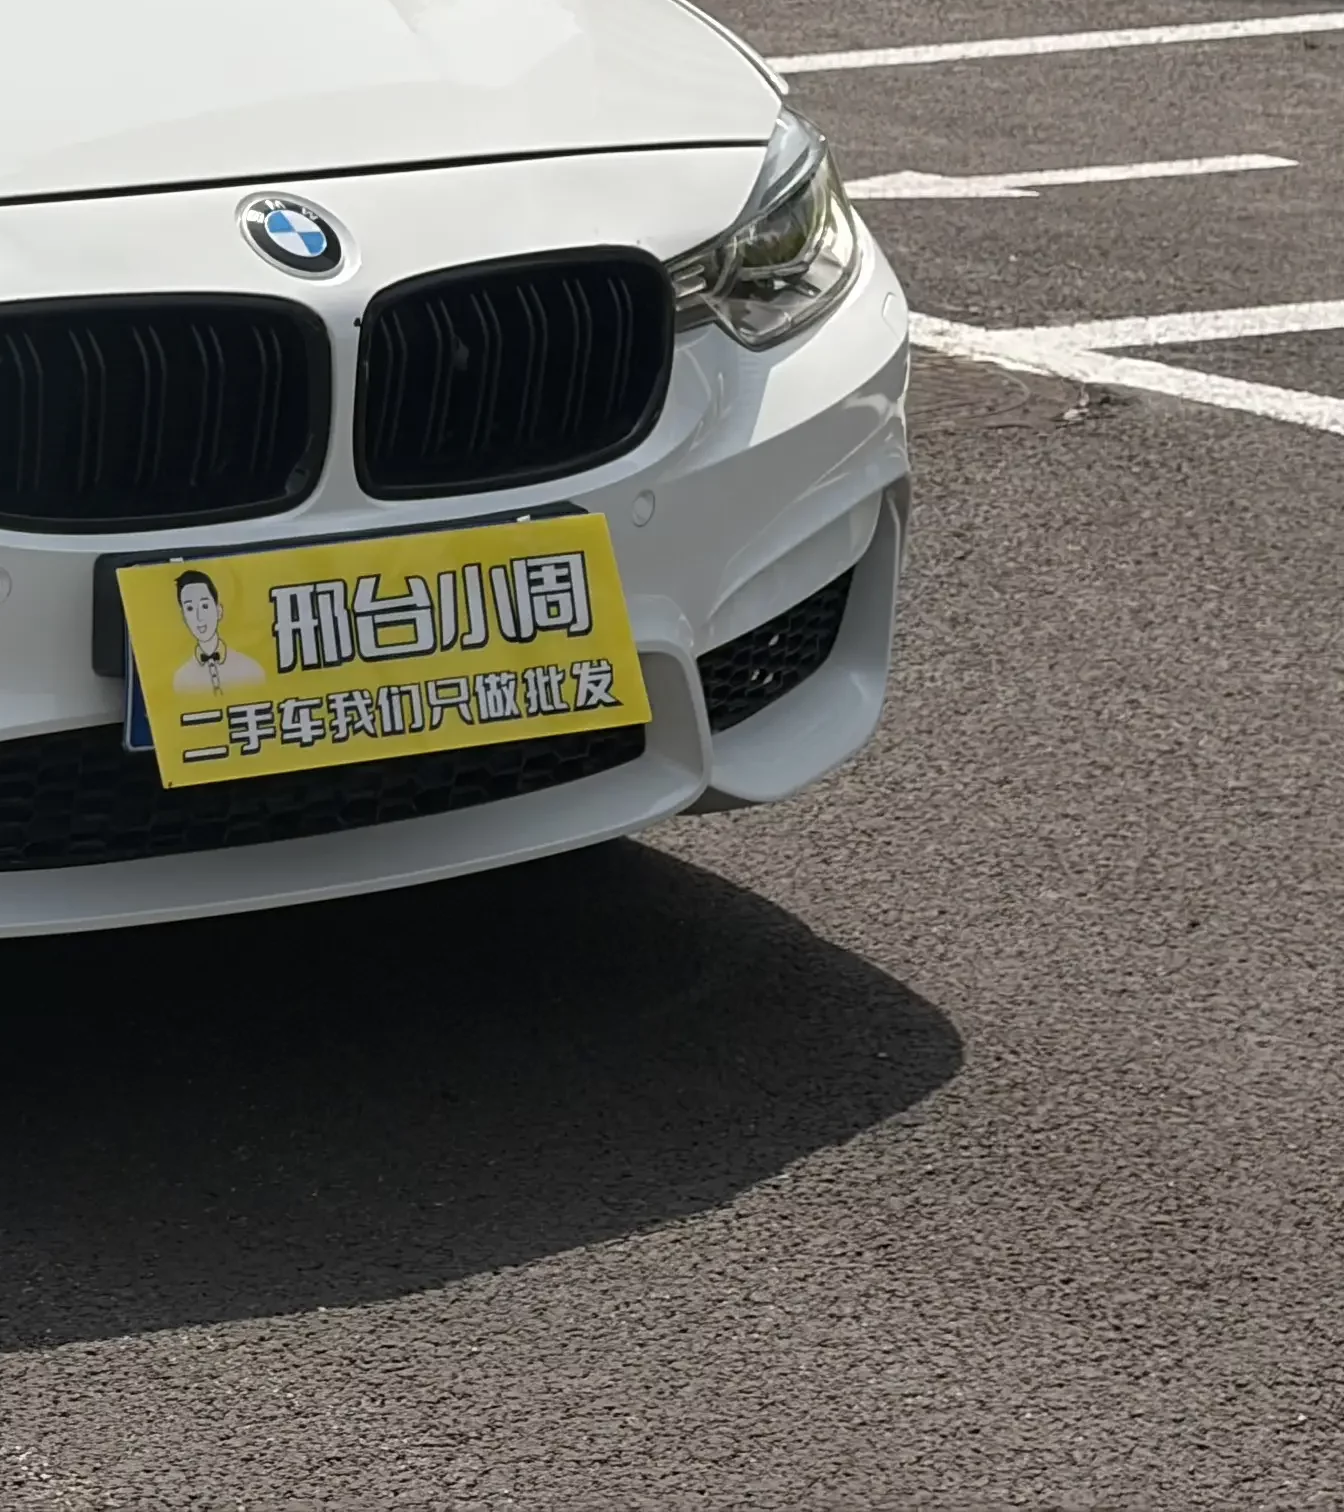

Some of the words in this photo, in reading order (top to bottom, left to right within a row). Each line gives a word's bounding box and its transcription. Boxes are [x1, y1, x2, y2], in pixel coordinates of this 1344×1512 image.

[271, 550, 593, 674] 邢台小周
[180, 658, 623, 763] 二手车我们只做批发
